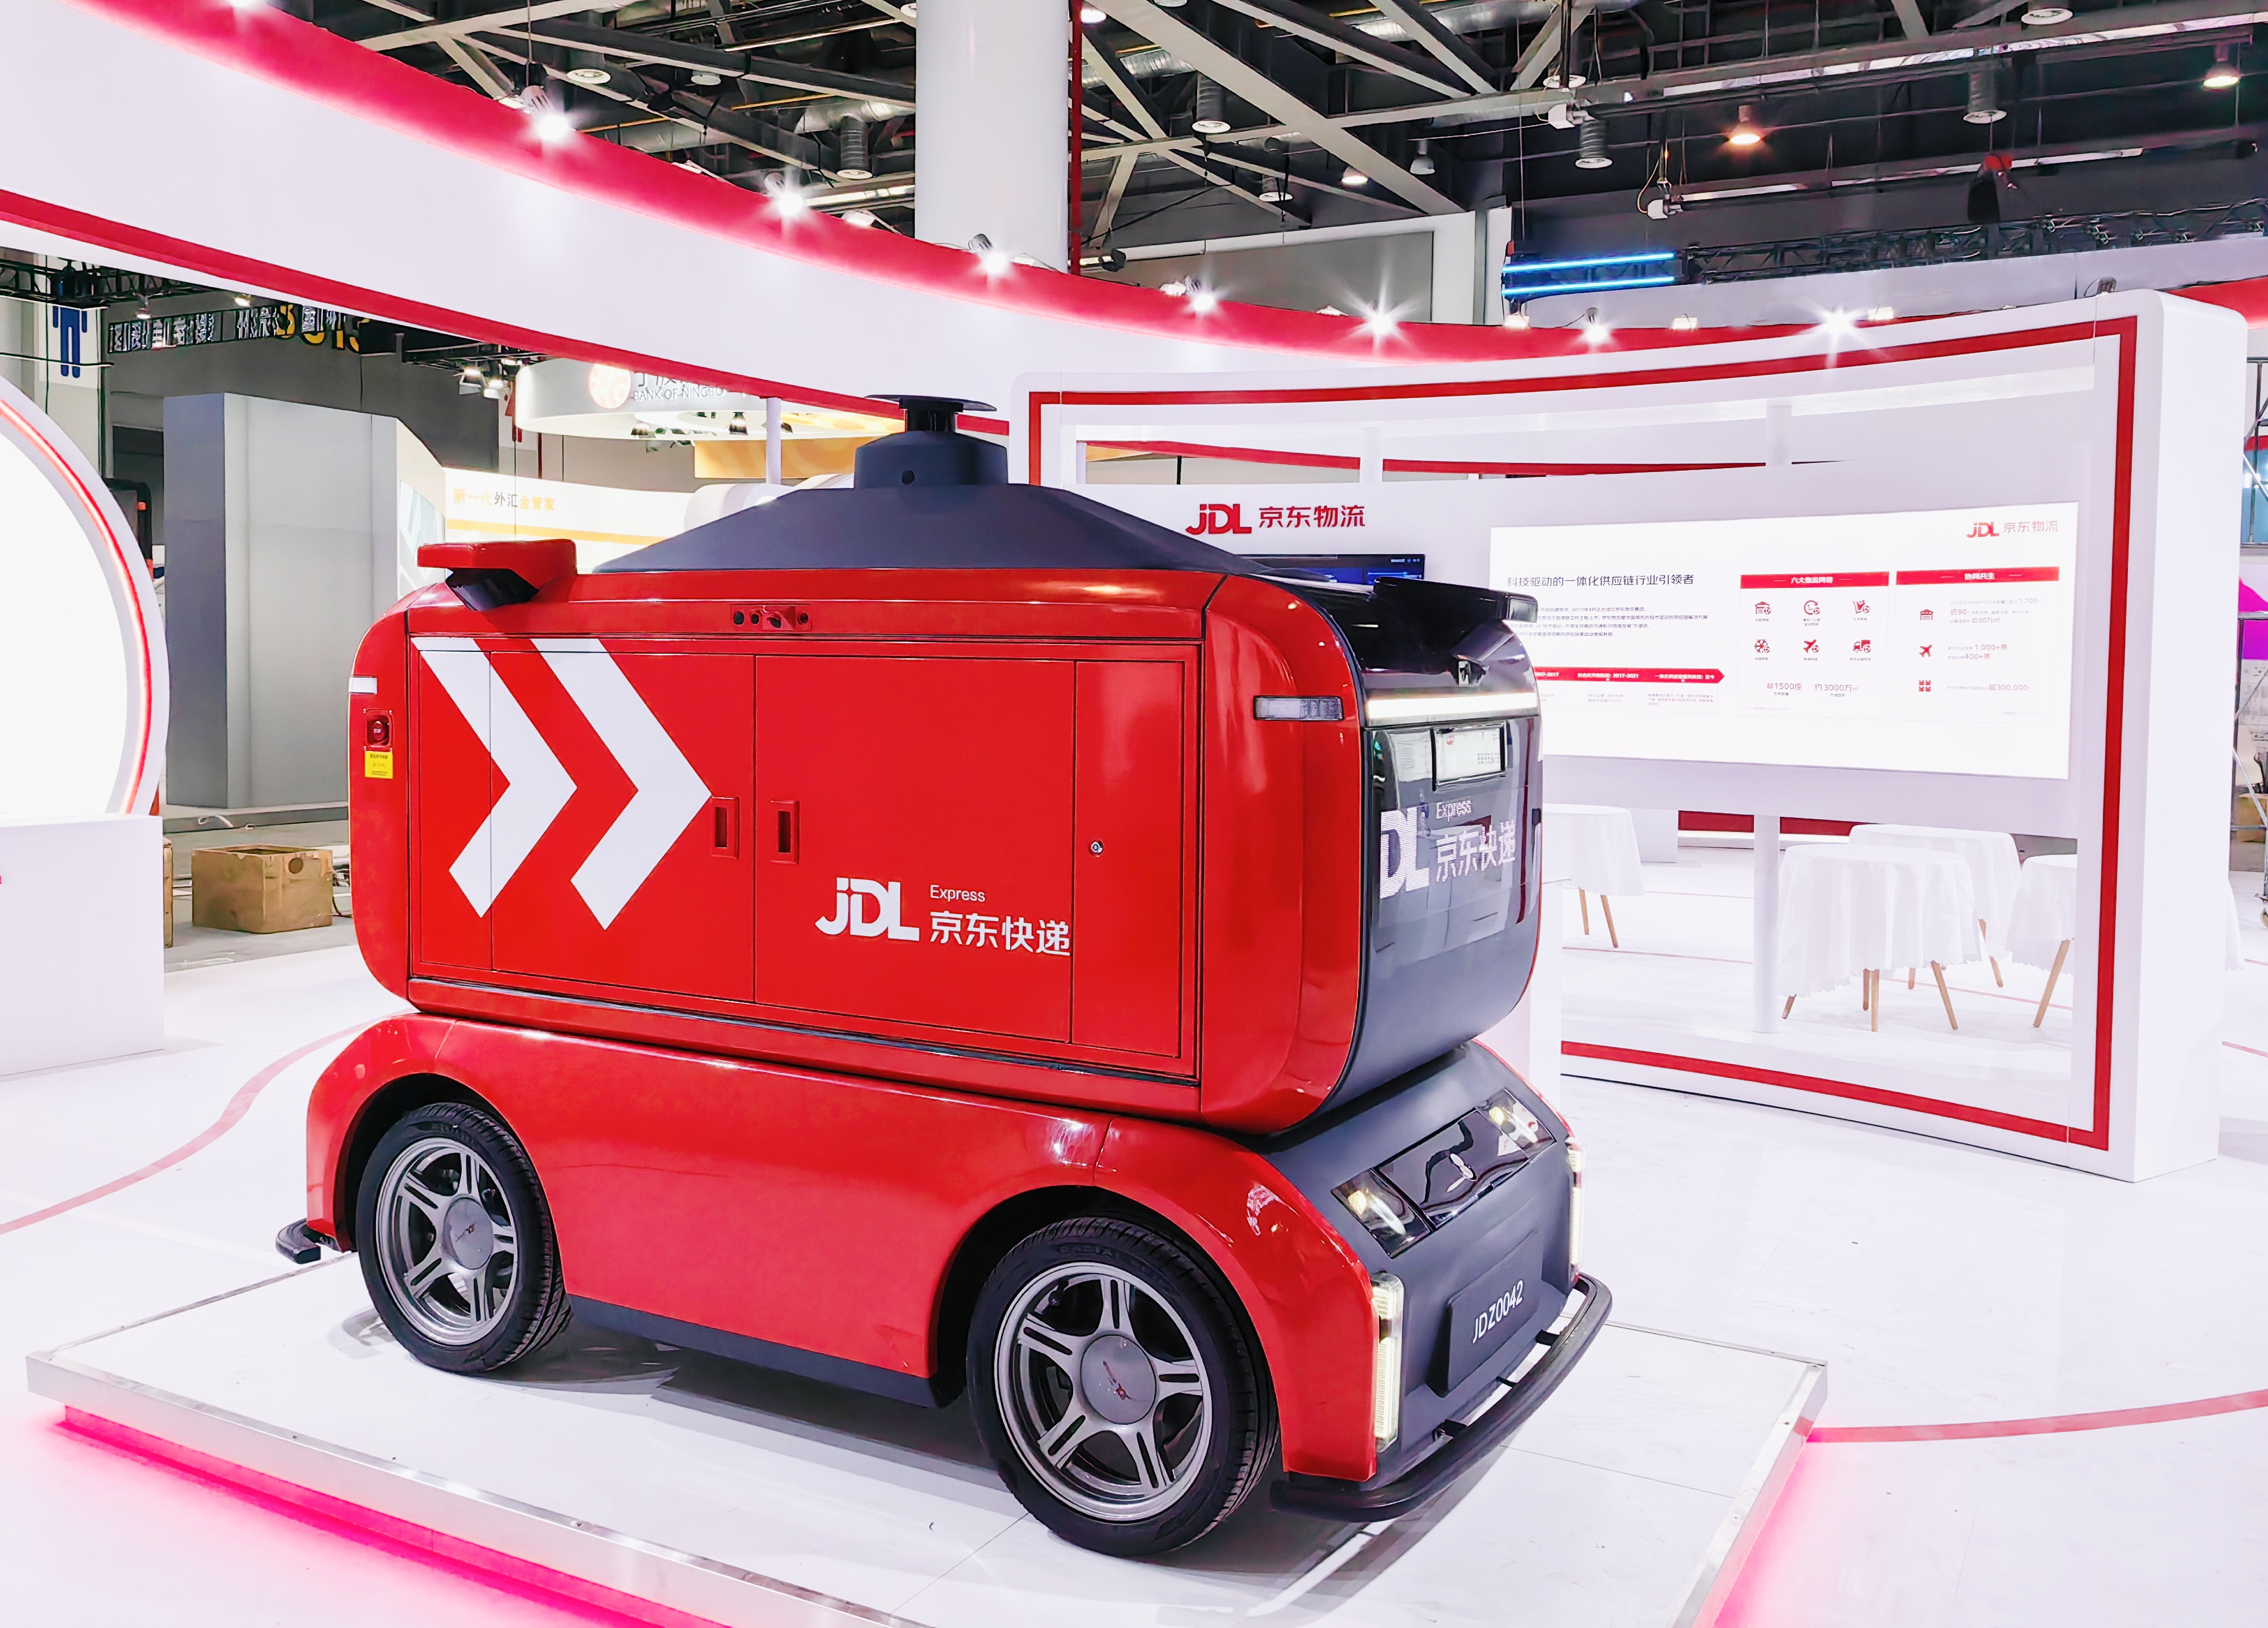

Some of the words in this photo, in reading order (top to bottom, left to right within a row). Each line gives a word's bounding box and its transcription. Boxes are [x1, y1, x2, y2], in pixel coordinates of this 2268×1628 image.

[634, 390, 662, 401] BANK
[665, 388, 678, 399] OF
[454, 488, 555, 511] 新一代外汇金管家
[1259, 505, 1365, 528] 京东物流
[2003, 521, 2059, 533] 京东物流
[1507, 574, 1694, 587] 科技驱动的一体化供应链行业引领者
[1435, 800, 1472, 823] Express
[1436, 820, 1516, 882] 京东快递
[930, 885, 986, 903] Express
[815, 877, 920, 942] JDL
[930, 910, 1071, 956] 京东快递
[1472, 1279, 1523, 1345] JDZ0042
